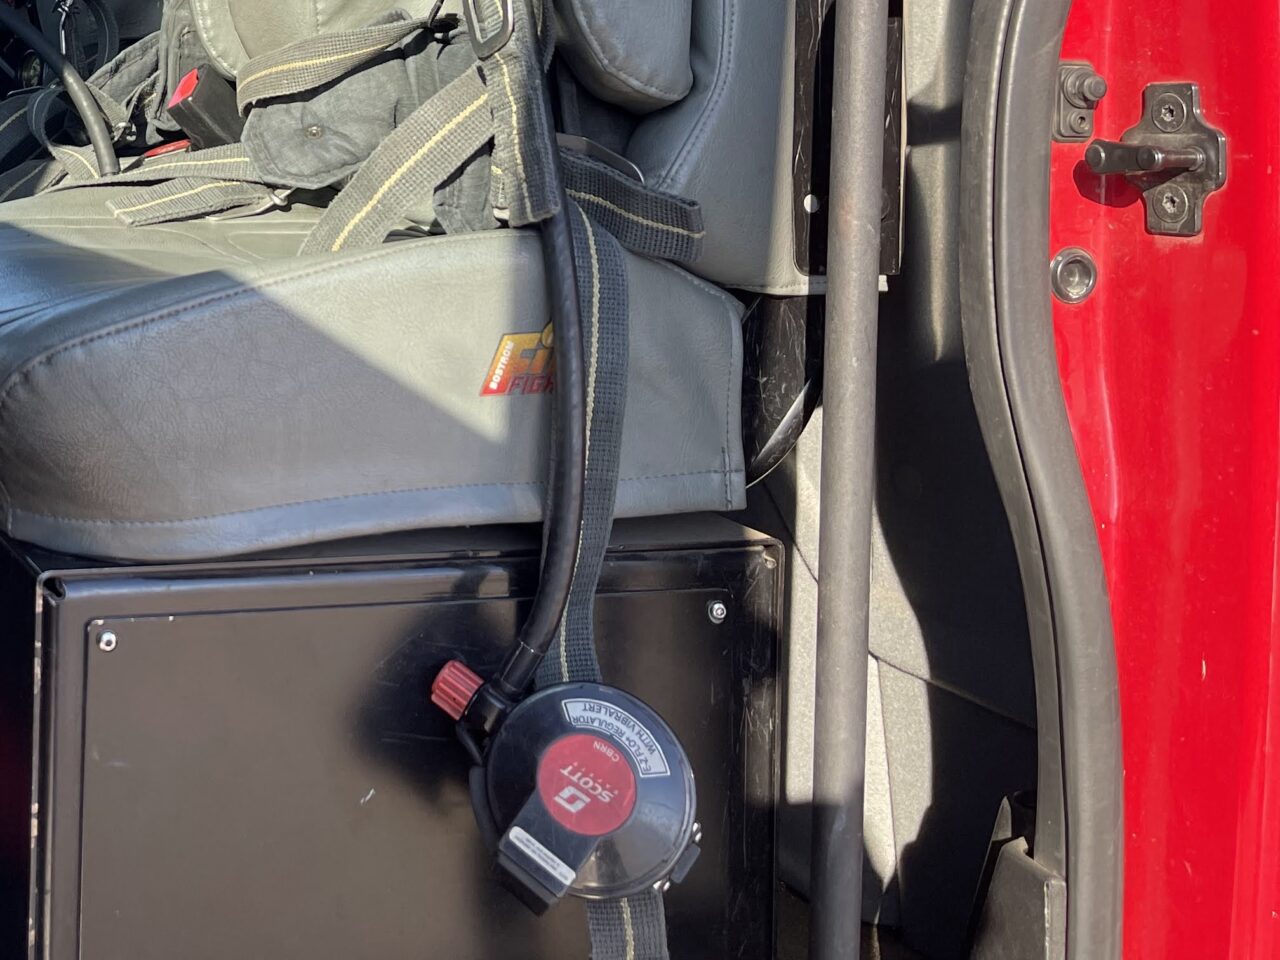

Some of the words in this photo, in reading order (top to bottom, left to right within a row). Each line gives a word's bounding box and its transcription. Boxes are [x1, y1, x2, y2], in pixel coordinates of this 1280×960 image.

[488, 340, 514, 390] BOSTROM
[571, 715, 626, 738] REGULATOR
[582, 702, 636, 732] VIBRALERT
[593, 740, 620, 762] CBRN
[635, 729, 657, 755] WITH
[560, 765, 615, 803] SCOTT
